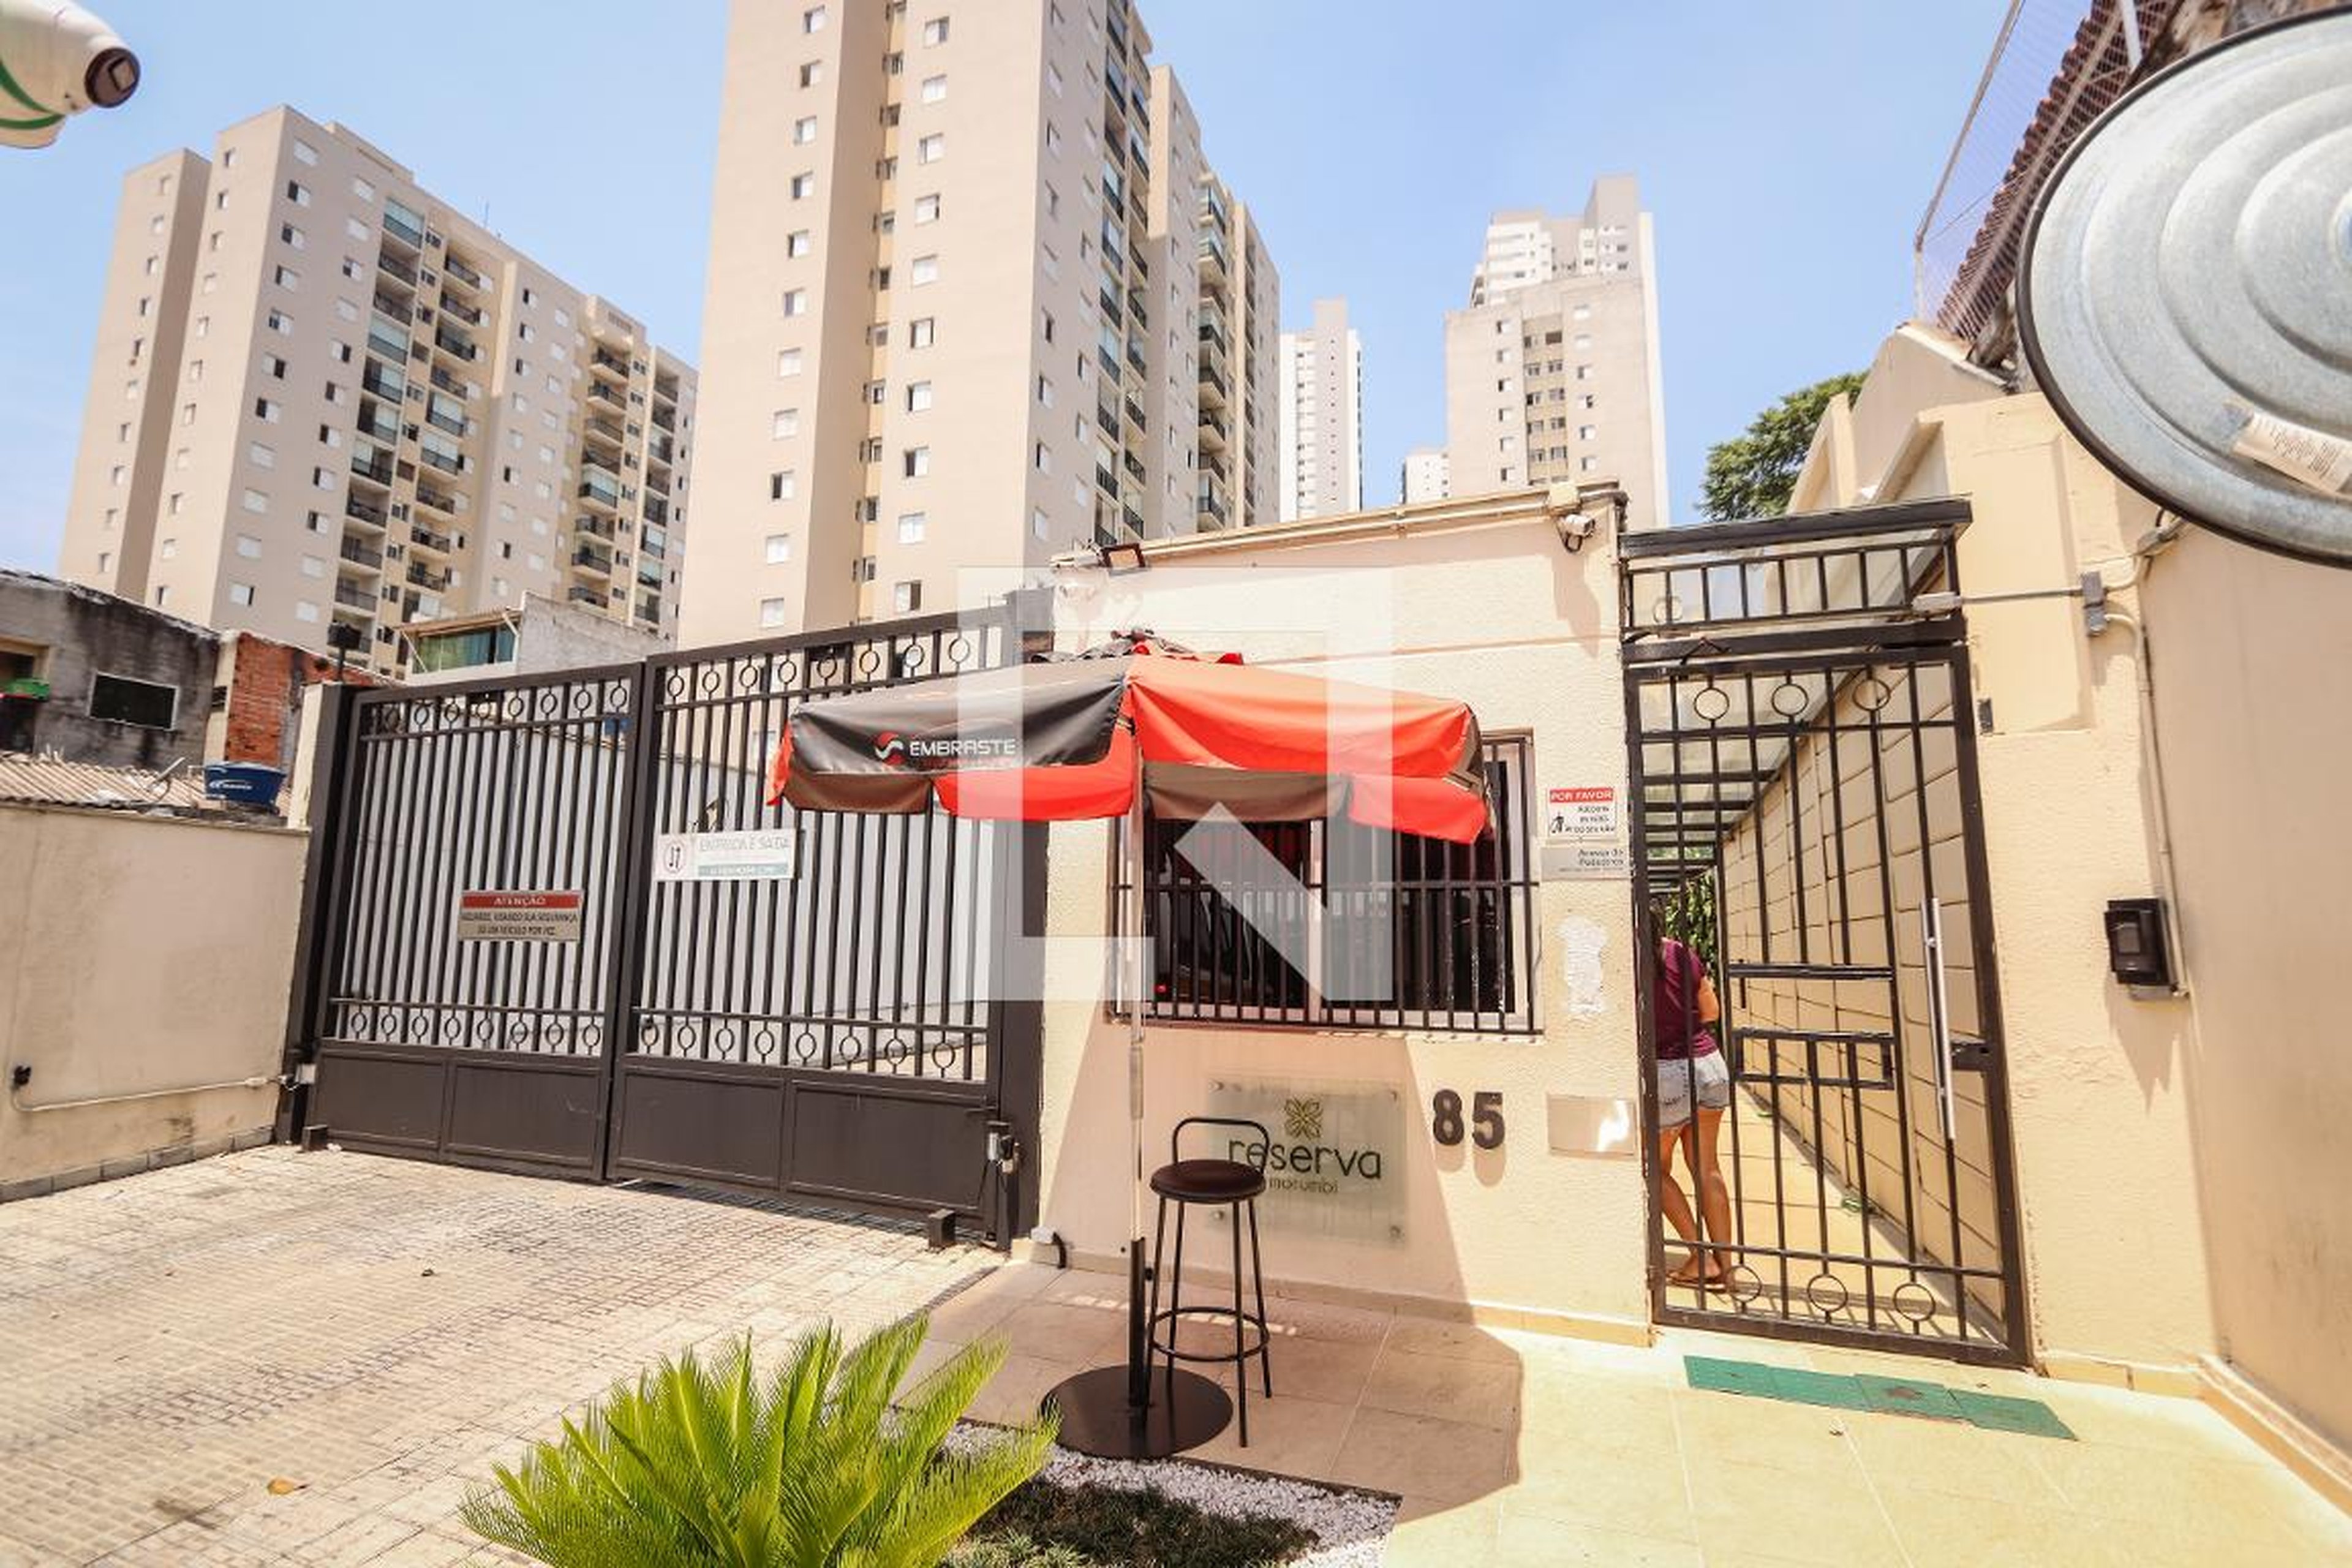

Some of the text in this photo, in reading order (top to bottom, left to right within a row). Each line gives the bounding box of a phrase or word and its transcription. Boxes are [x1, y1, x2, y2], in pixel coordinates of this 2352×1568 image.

[910, 739, 1016, 756] EMBRASTE
[1551, 790, 1612, 801] POR FAVOR
[494, 895, 547, 906] ATENÇÃO
[1433, 1089, 1505, 1150] 85
[1228, 1138, 1382, 1180] reserva
